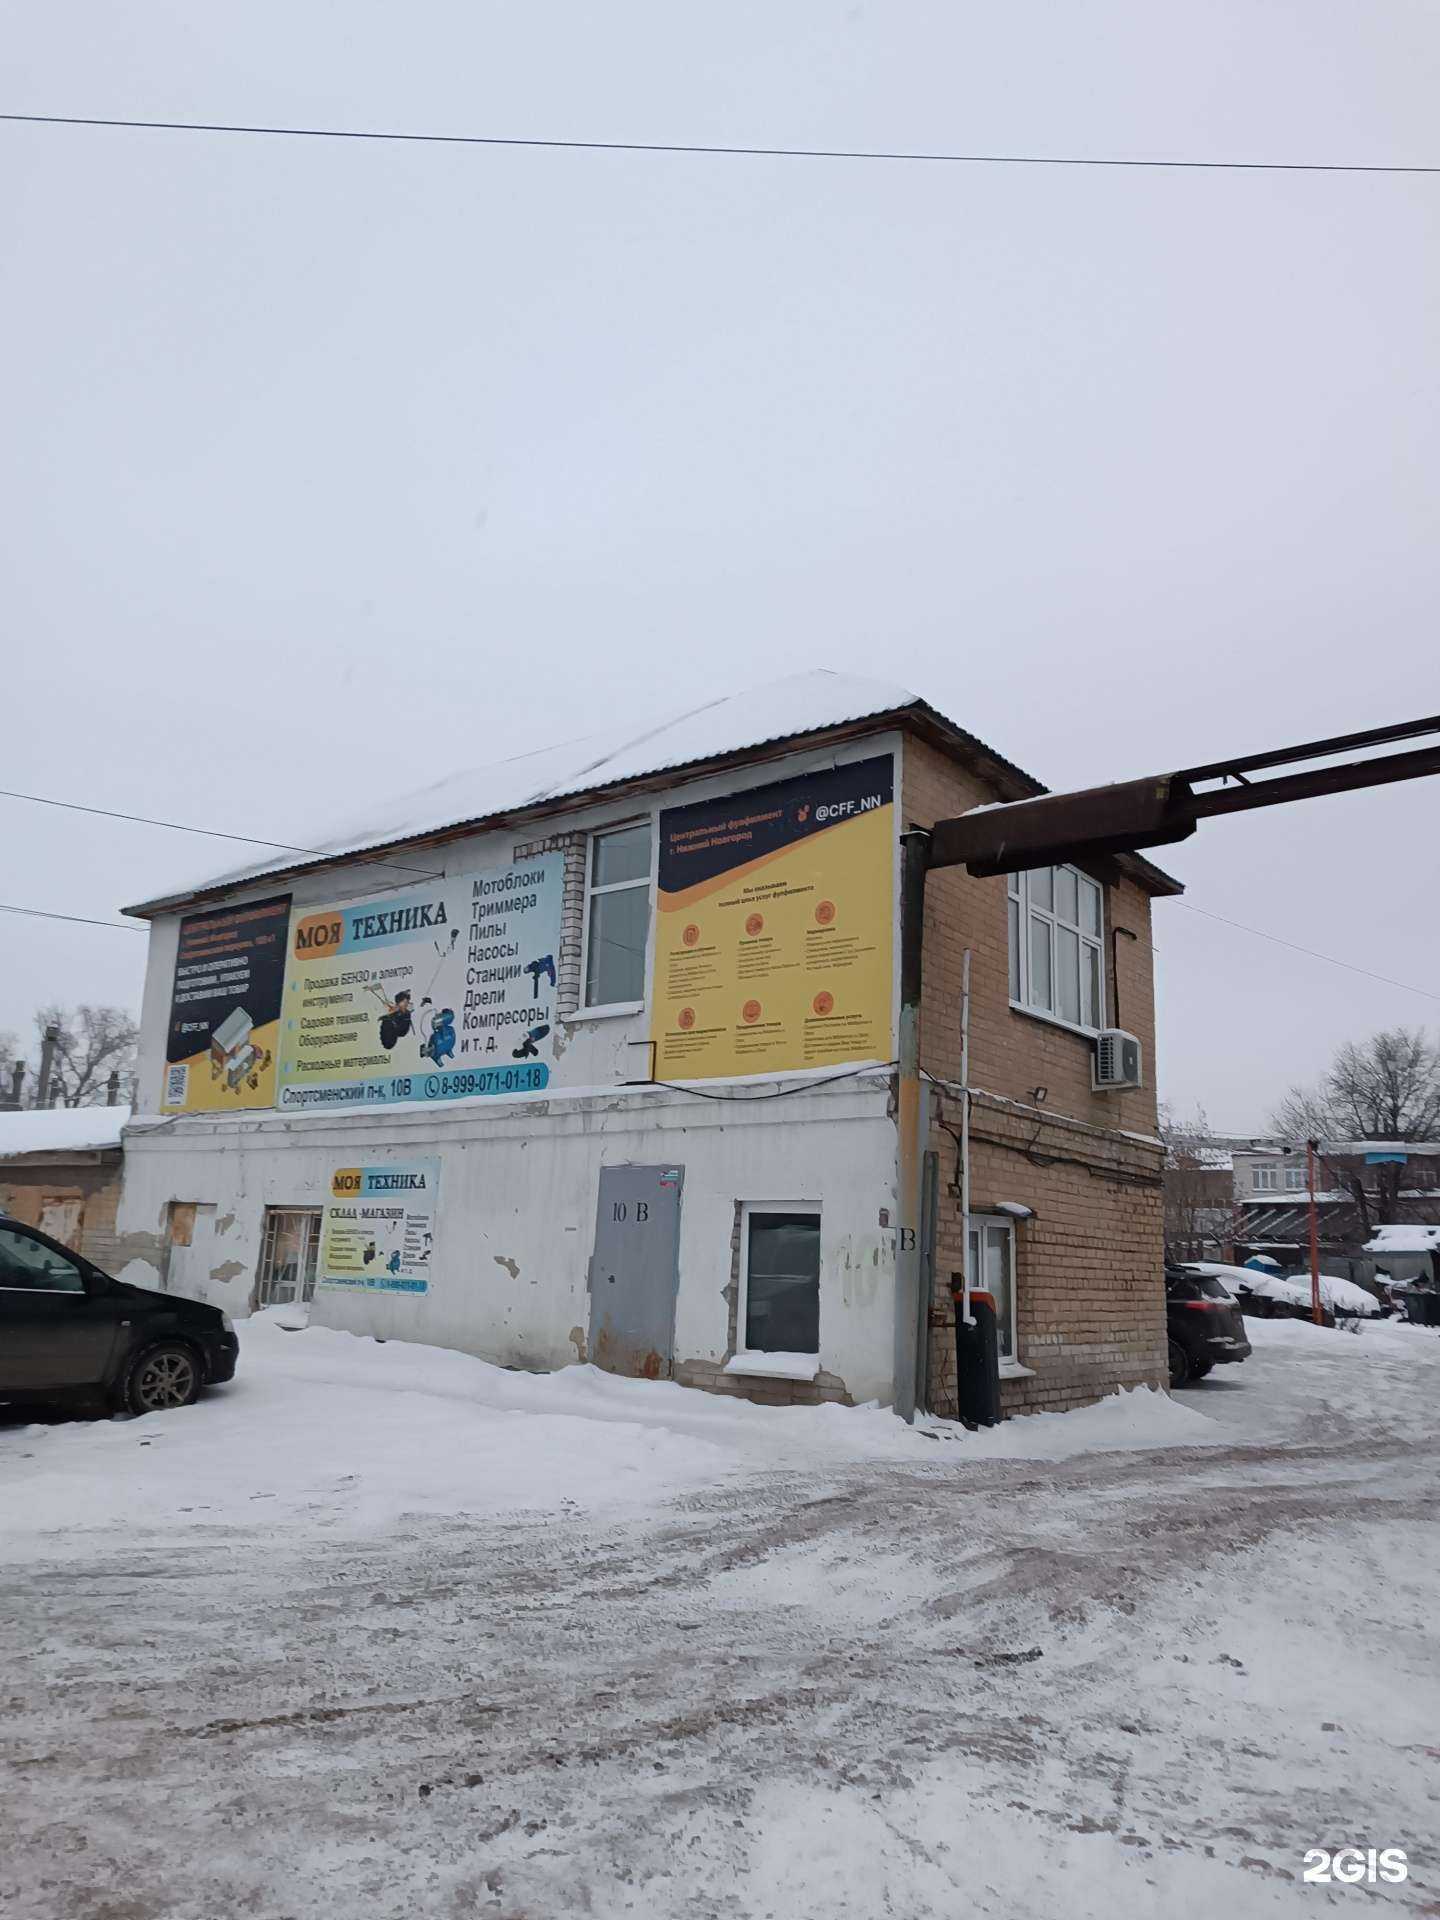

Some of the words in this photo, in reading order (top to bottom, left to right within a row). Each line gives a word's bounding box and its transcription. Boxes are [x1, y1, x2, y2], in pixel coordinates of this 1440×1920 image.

[815, 794, 882, 821] @CFF_NN
[472, 869, 545, 898] Мотоблоки
[471, 893, 537, 923] Триммера
[296, 922, 342, 950] МОЯ
[352, 901, 448, 940] ТЕХНИКА
[469, 922, 507, 941] Пилы
[467, 942, 519, 963] Насосы
[340, 969, 369, 985] БЕНЗО
[379, 964, 414, 981] электро
[466, 963, 522, 985] Станции
[463, 989, 505, 1011] Дрели
[462, 1006, 549, 1031] Компресоры
[461, 1039, 469, 1052] и
[282, 1083, 365, 1107] Спортсменский
[391, 1079, 411, 1097] 10В
[441, 1068, 541, 1095] 8-999-071-01-18
[333, 1175, 362, 1190] МОЯ
[367, 1174, 426, 1190] ТЕХНИКА
[613, 1202, 627, 1222] 10
[636, 1202, 649, 1222] В
